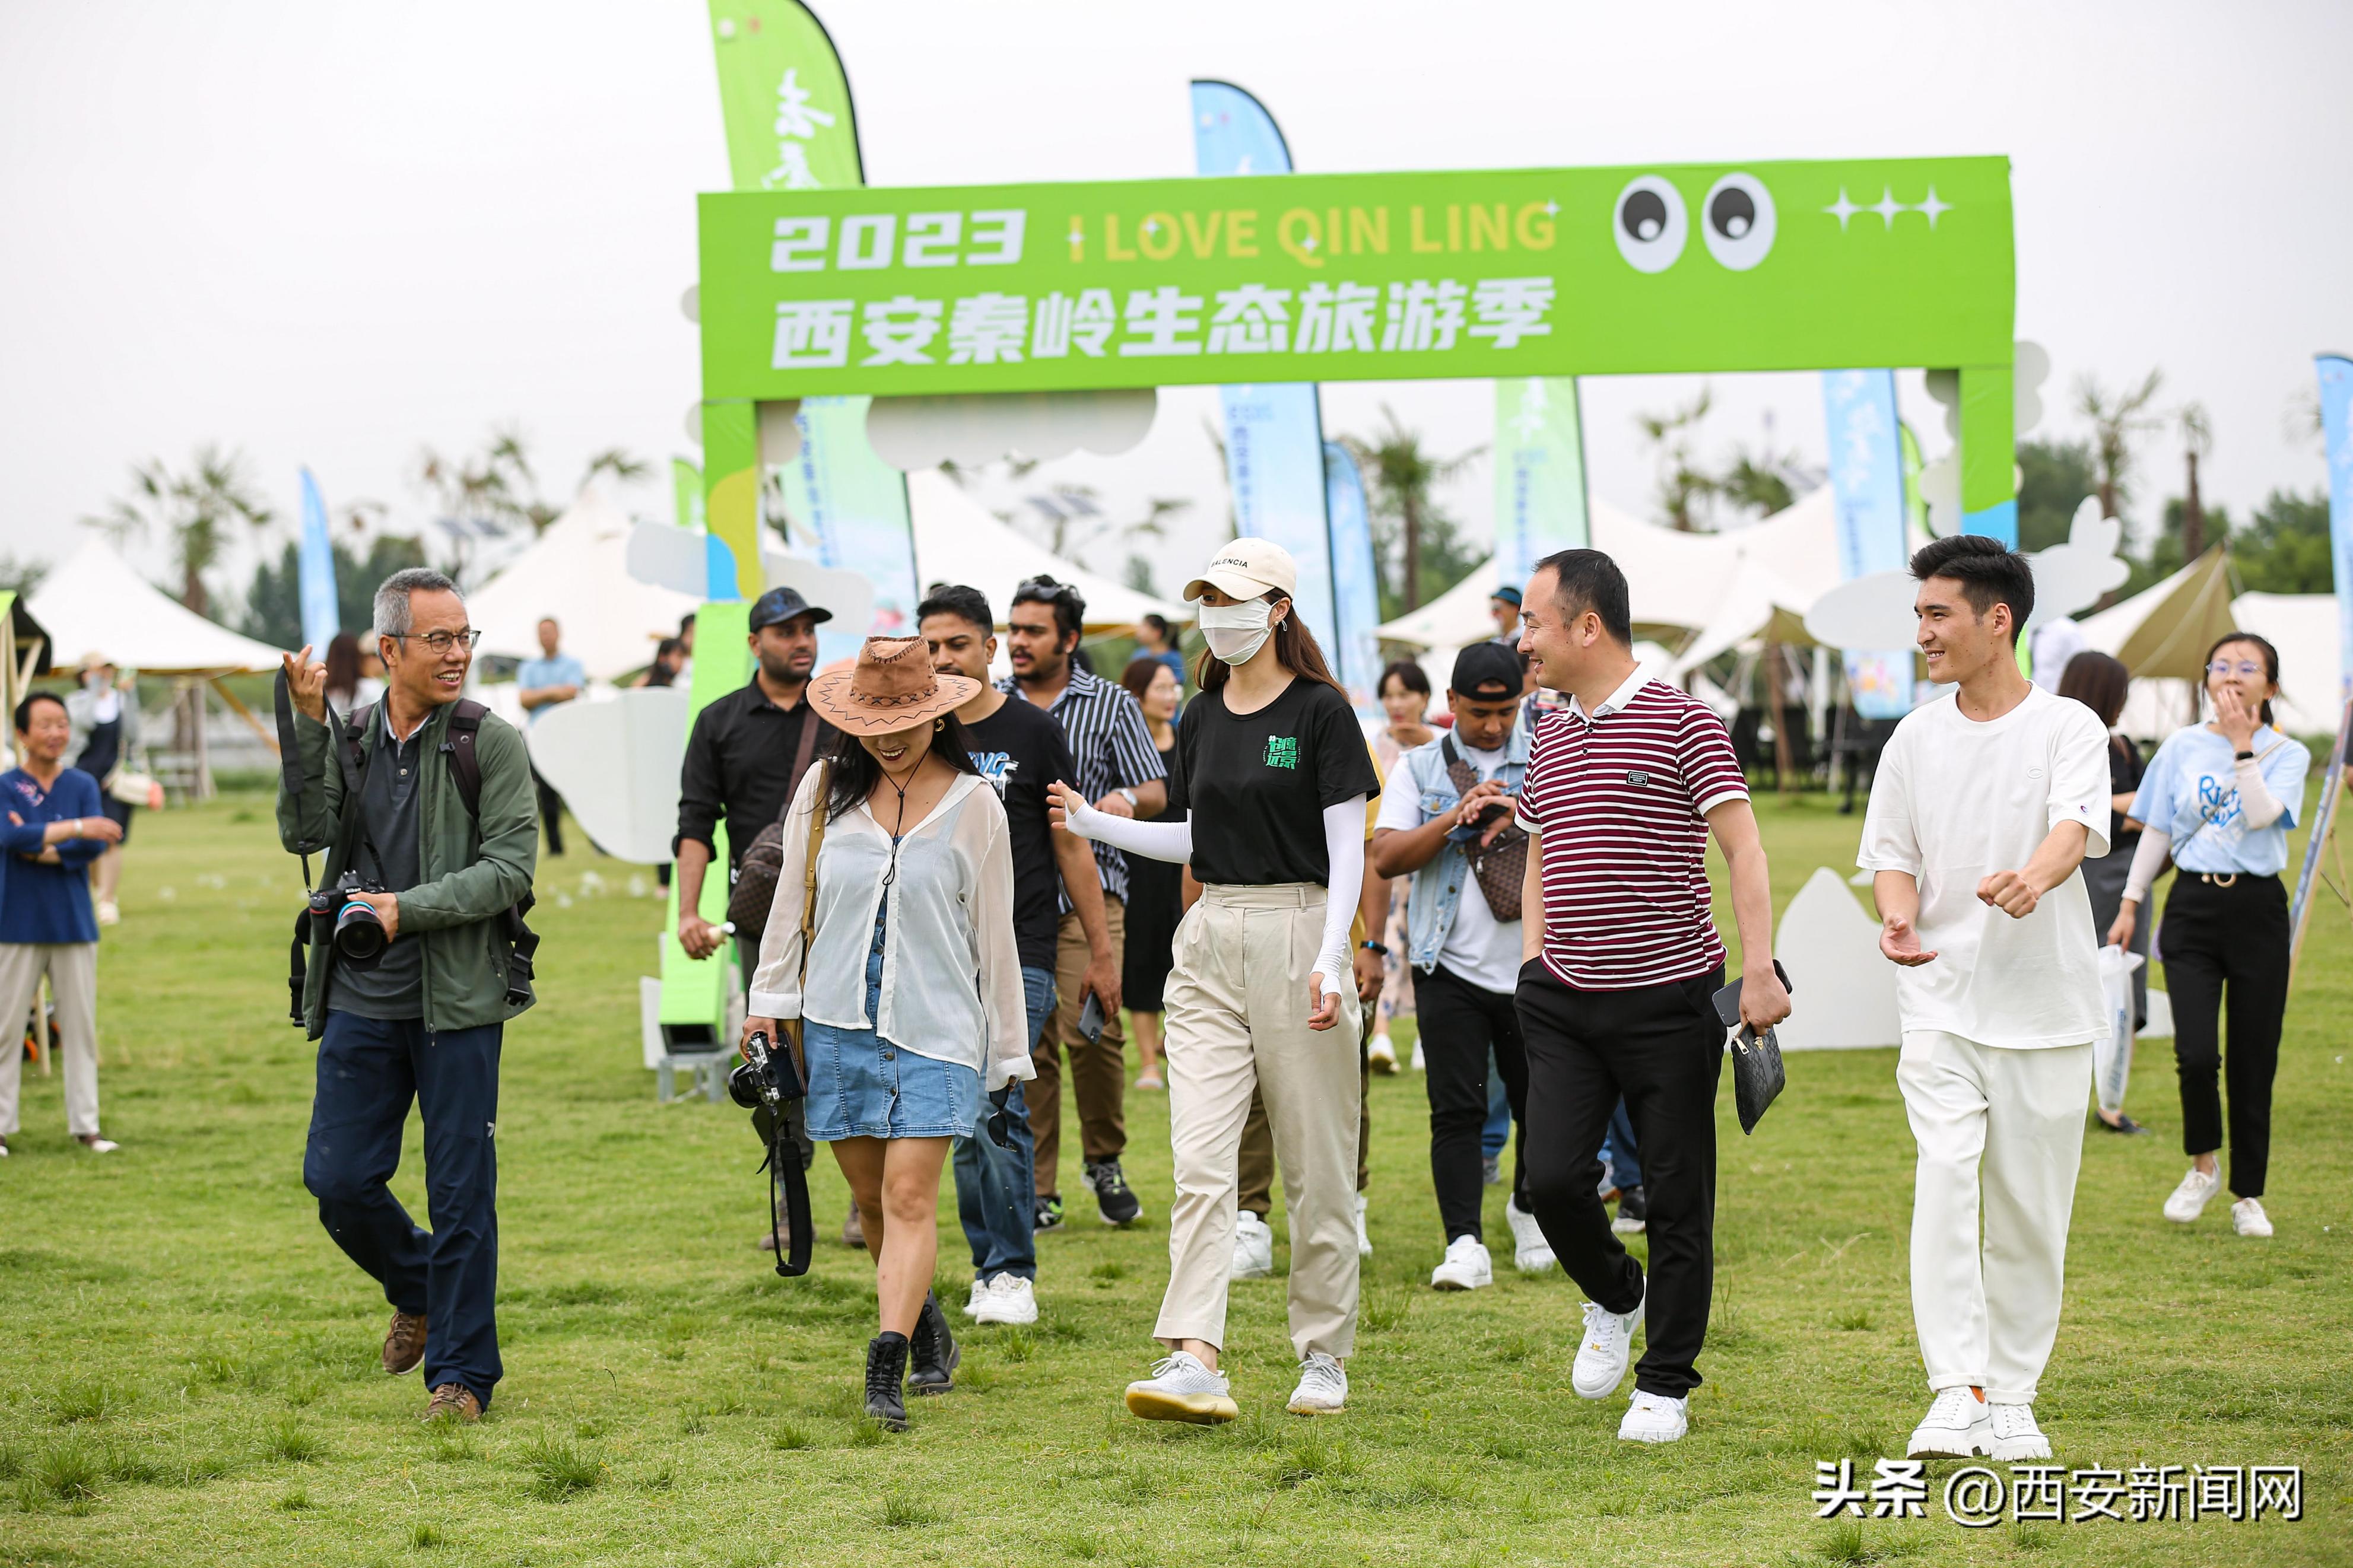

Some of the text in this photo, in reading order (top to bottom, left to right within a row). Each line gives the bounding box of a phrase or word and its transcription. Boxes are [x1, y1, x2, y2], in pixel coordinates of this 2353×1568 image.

[770, 209, 1027, 272] 2023
[1069, 201, 1557, 268] I LOVE QIN LING
[771, 276, 1556, 370] 西安秦岭生态旅游季
